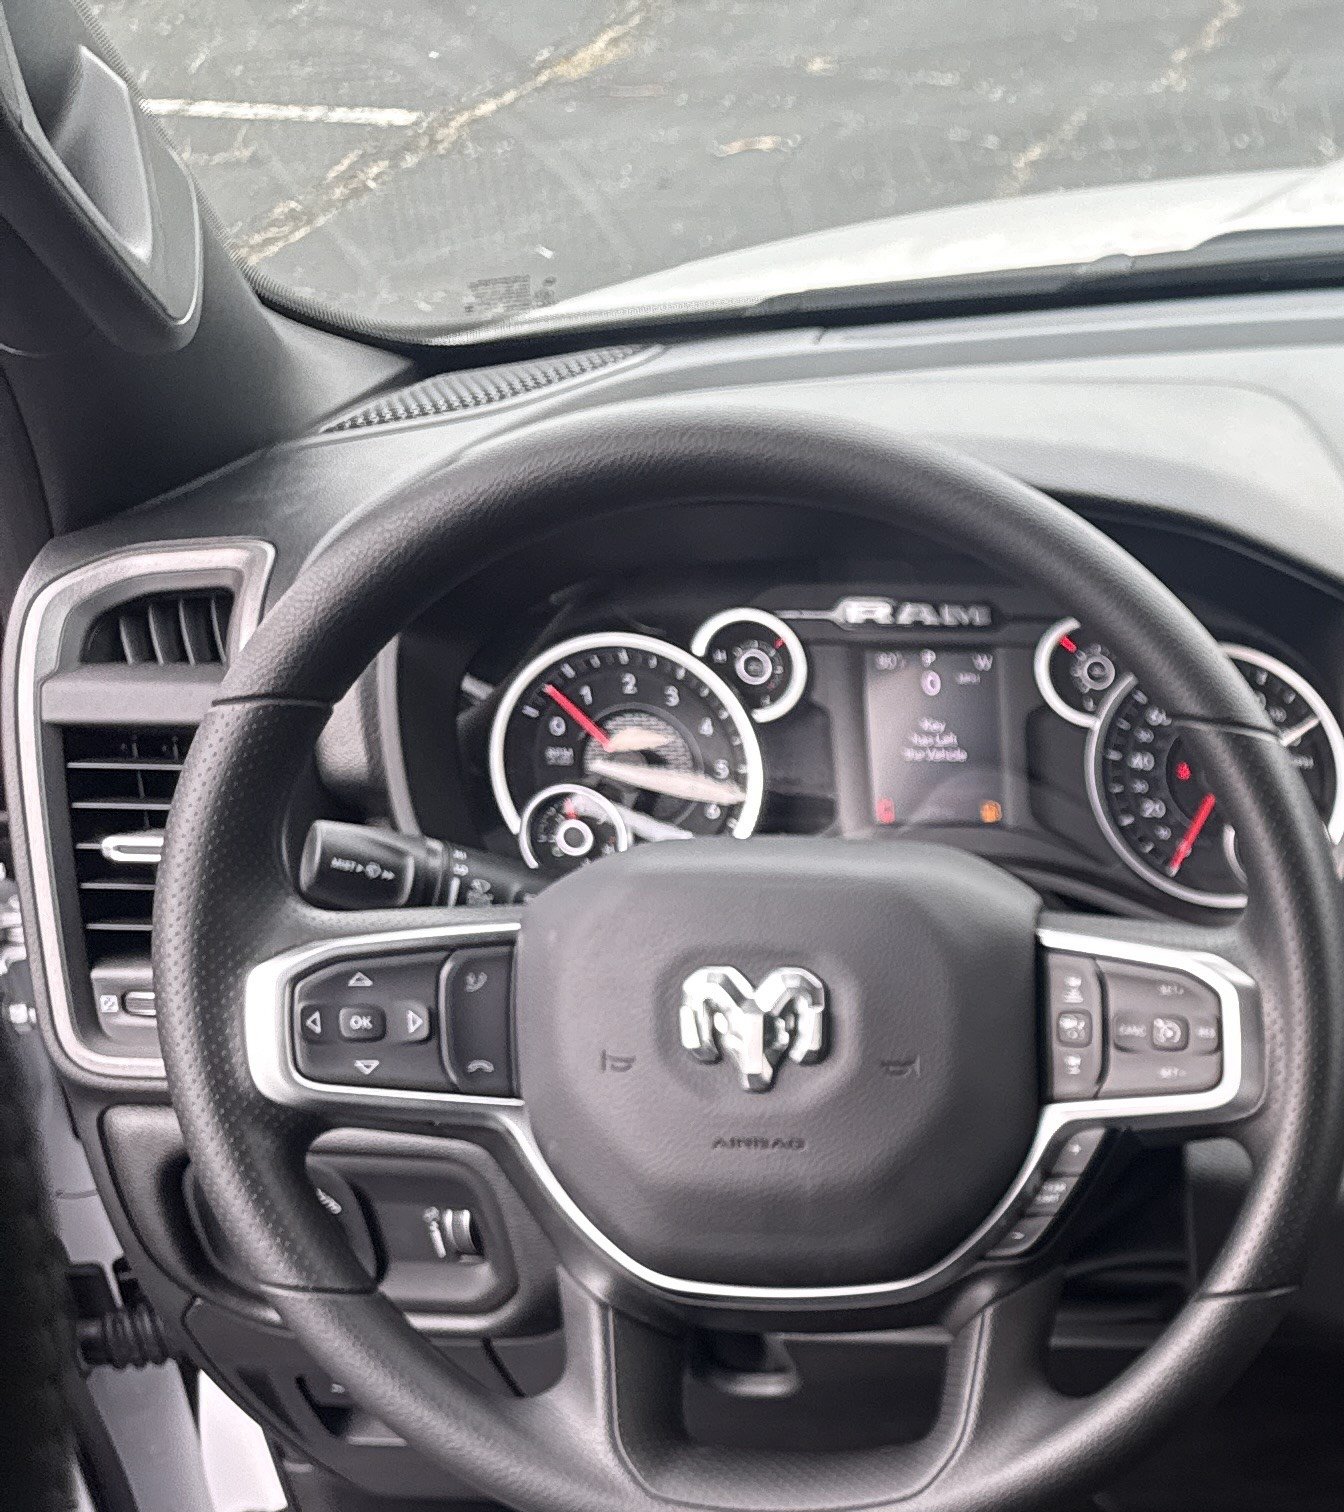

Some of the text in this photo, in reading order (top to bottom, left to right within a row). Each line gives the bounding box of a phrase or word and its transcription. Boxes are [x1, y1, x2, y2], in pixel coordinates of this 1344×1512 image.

[844, 601, 992, 627] RAM
[621, 672, 638, 695] 2
[579, 685, 593, 705] 1
[664, 685, 680, 707] 3
[549, 716, 566, 737] 0
[699, 716, 714, 736] 4
[713, 759, 730, 780] 5
[349, 1014, 373, 1030] OK
[711, 1135, 807, 1151] AIRBAG
